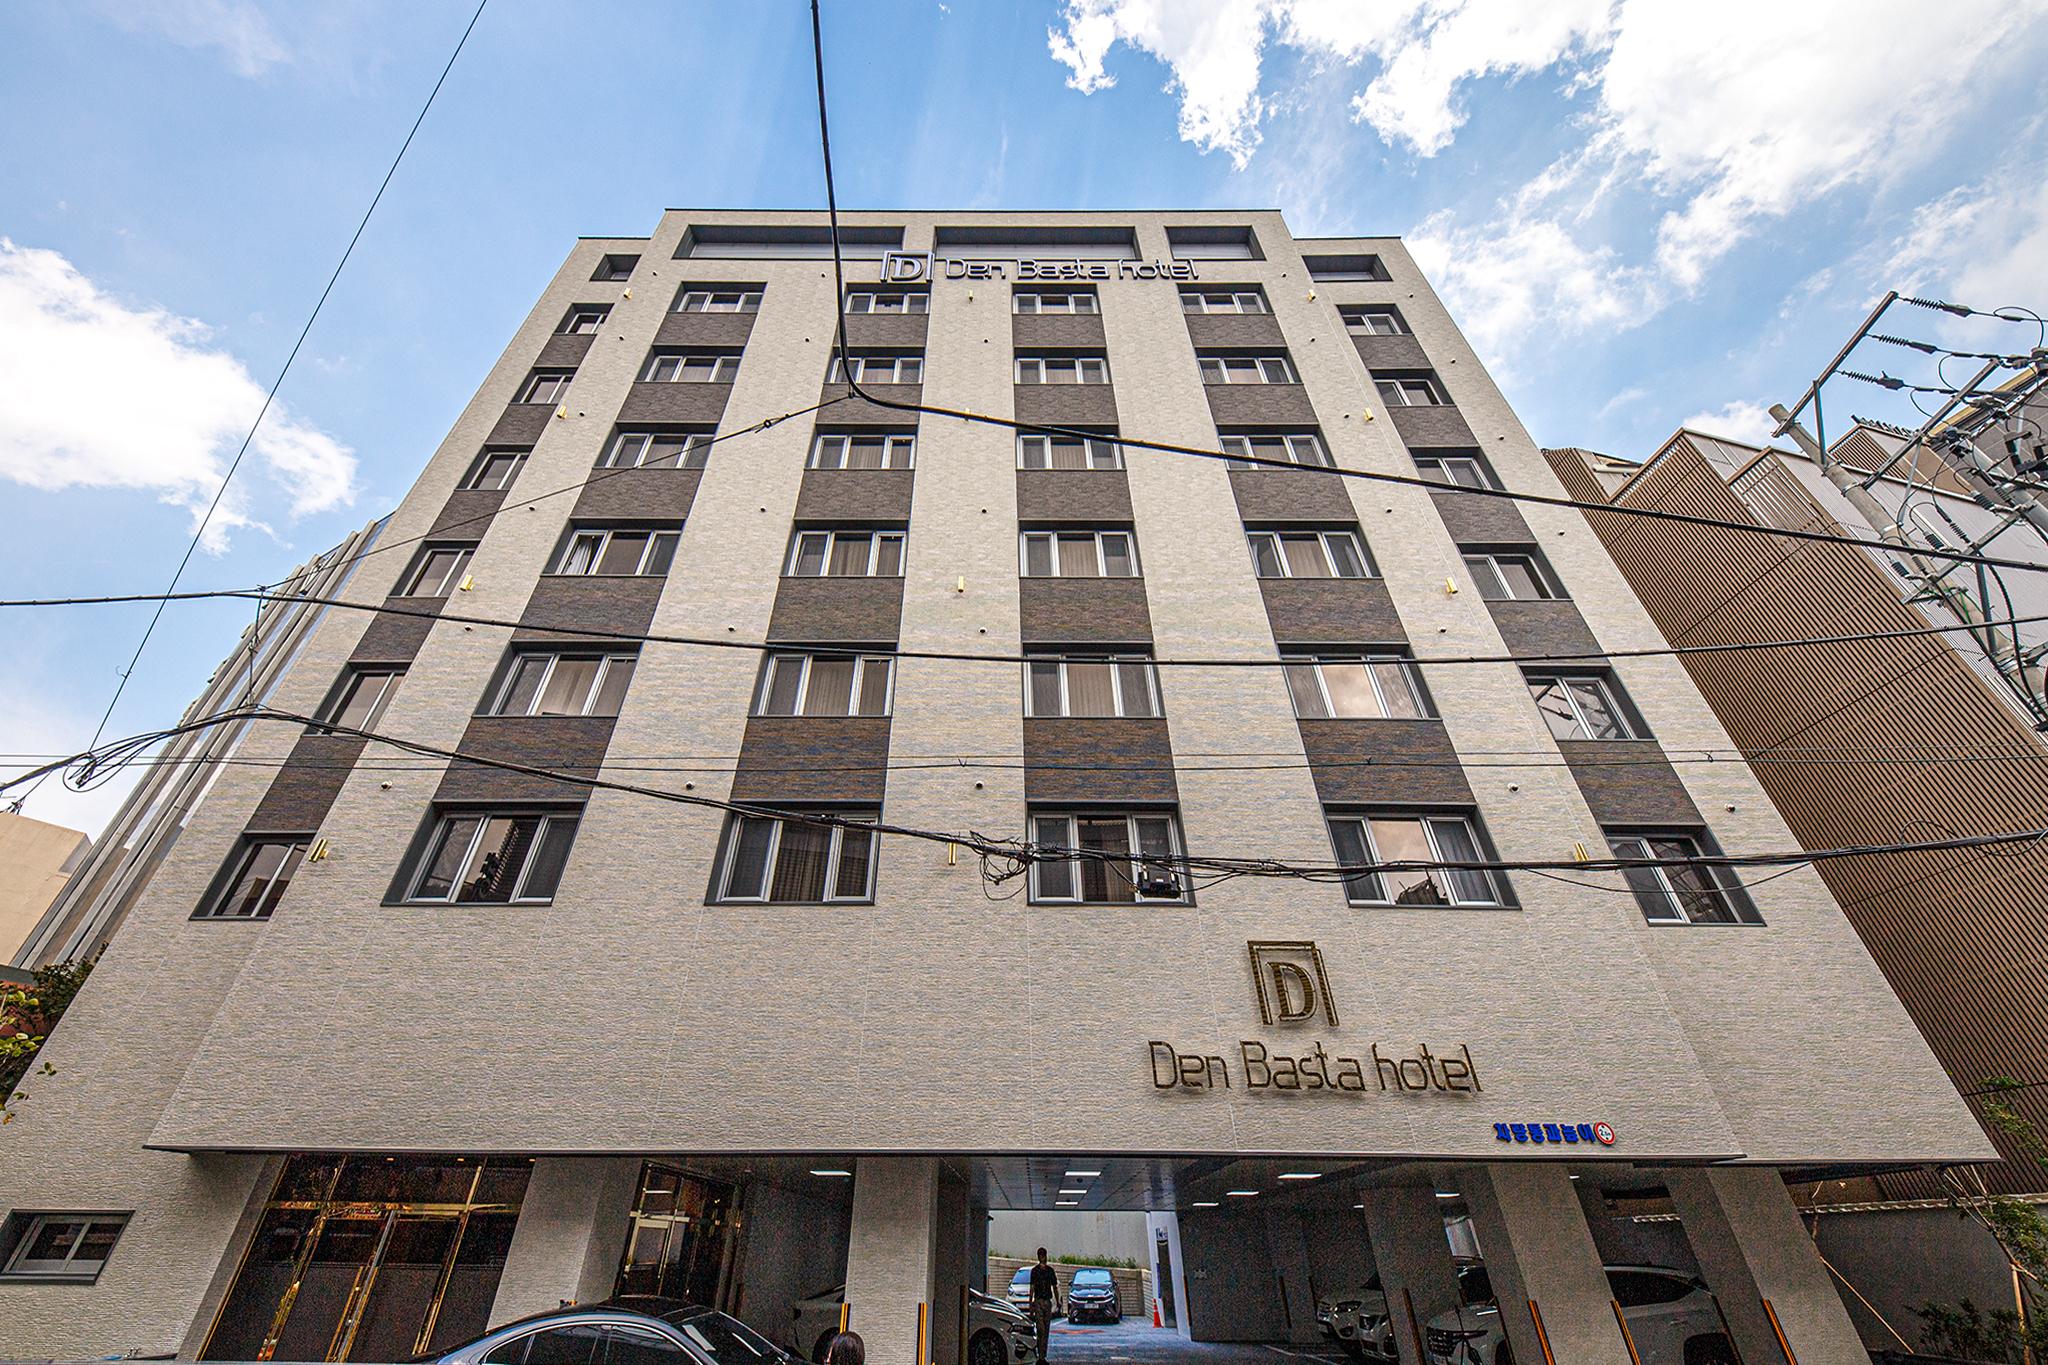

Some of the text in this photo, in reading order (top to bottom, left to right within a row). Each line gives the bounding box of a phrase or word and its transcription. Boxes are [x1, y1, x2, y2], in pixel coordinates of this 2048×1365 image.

[945, 257, 1200, 280] Den Basta hotel
[1148, 1039, 1484, 1093] Den Basta hotel
